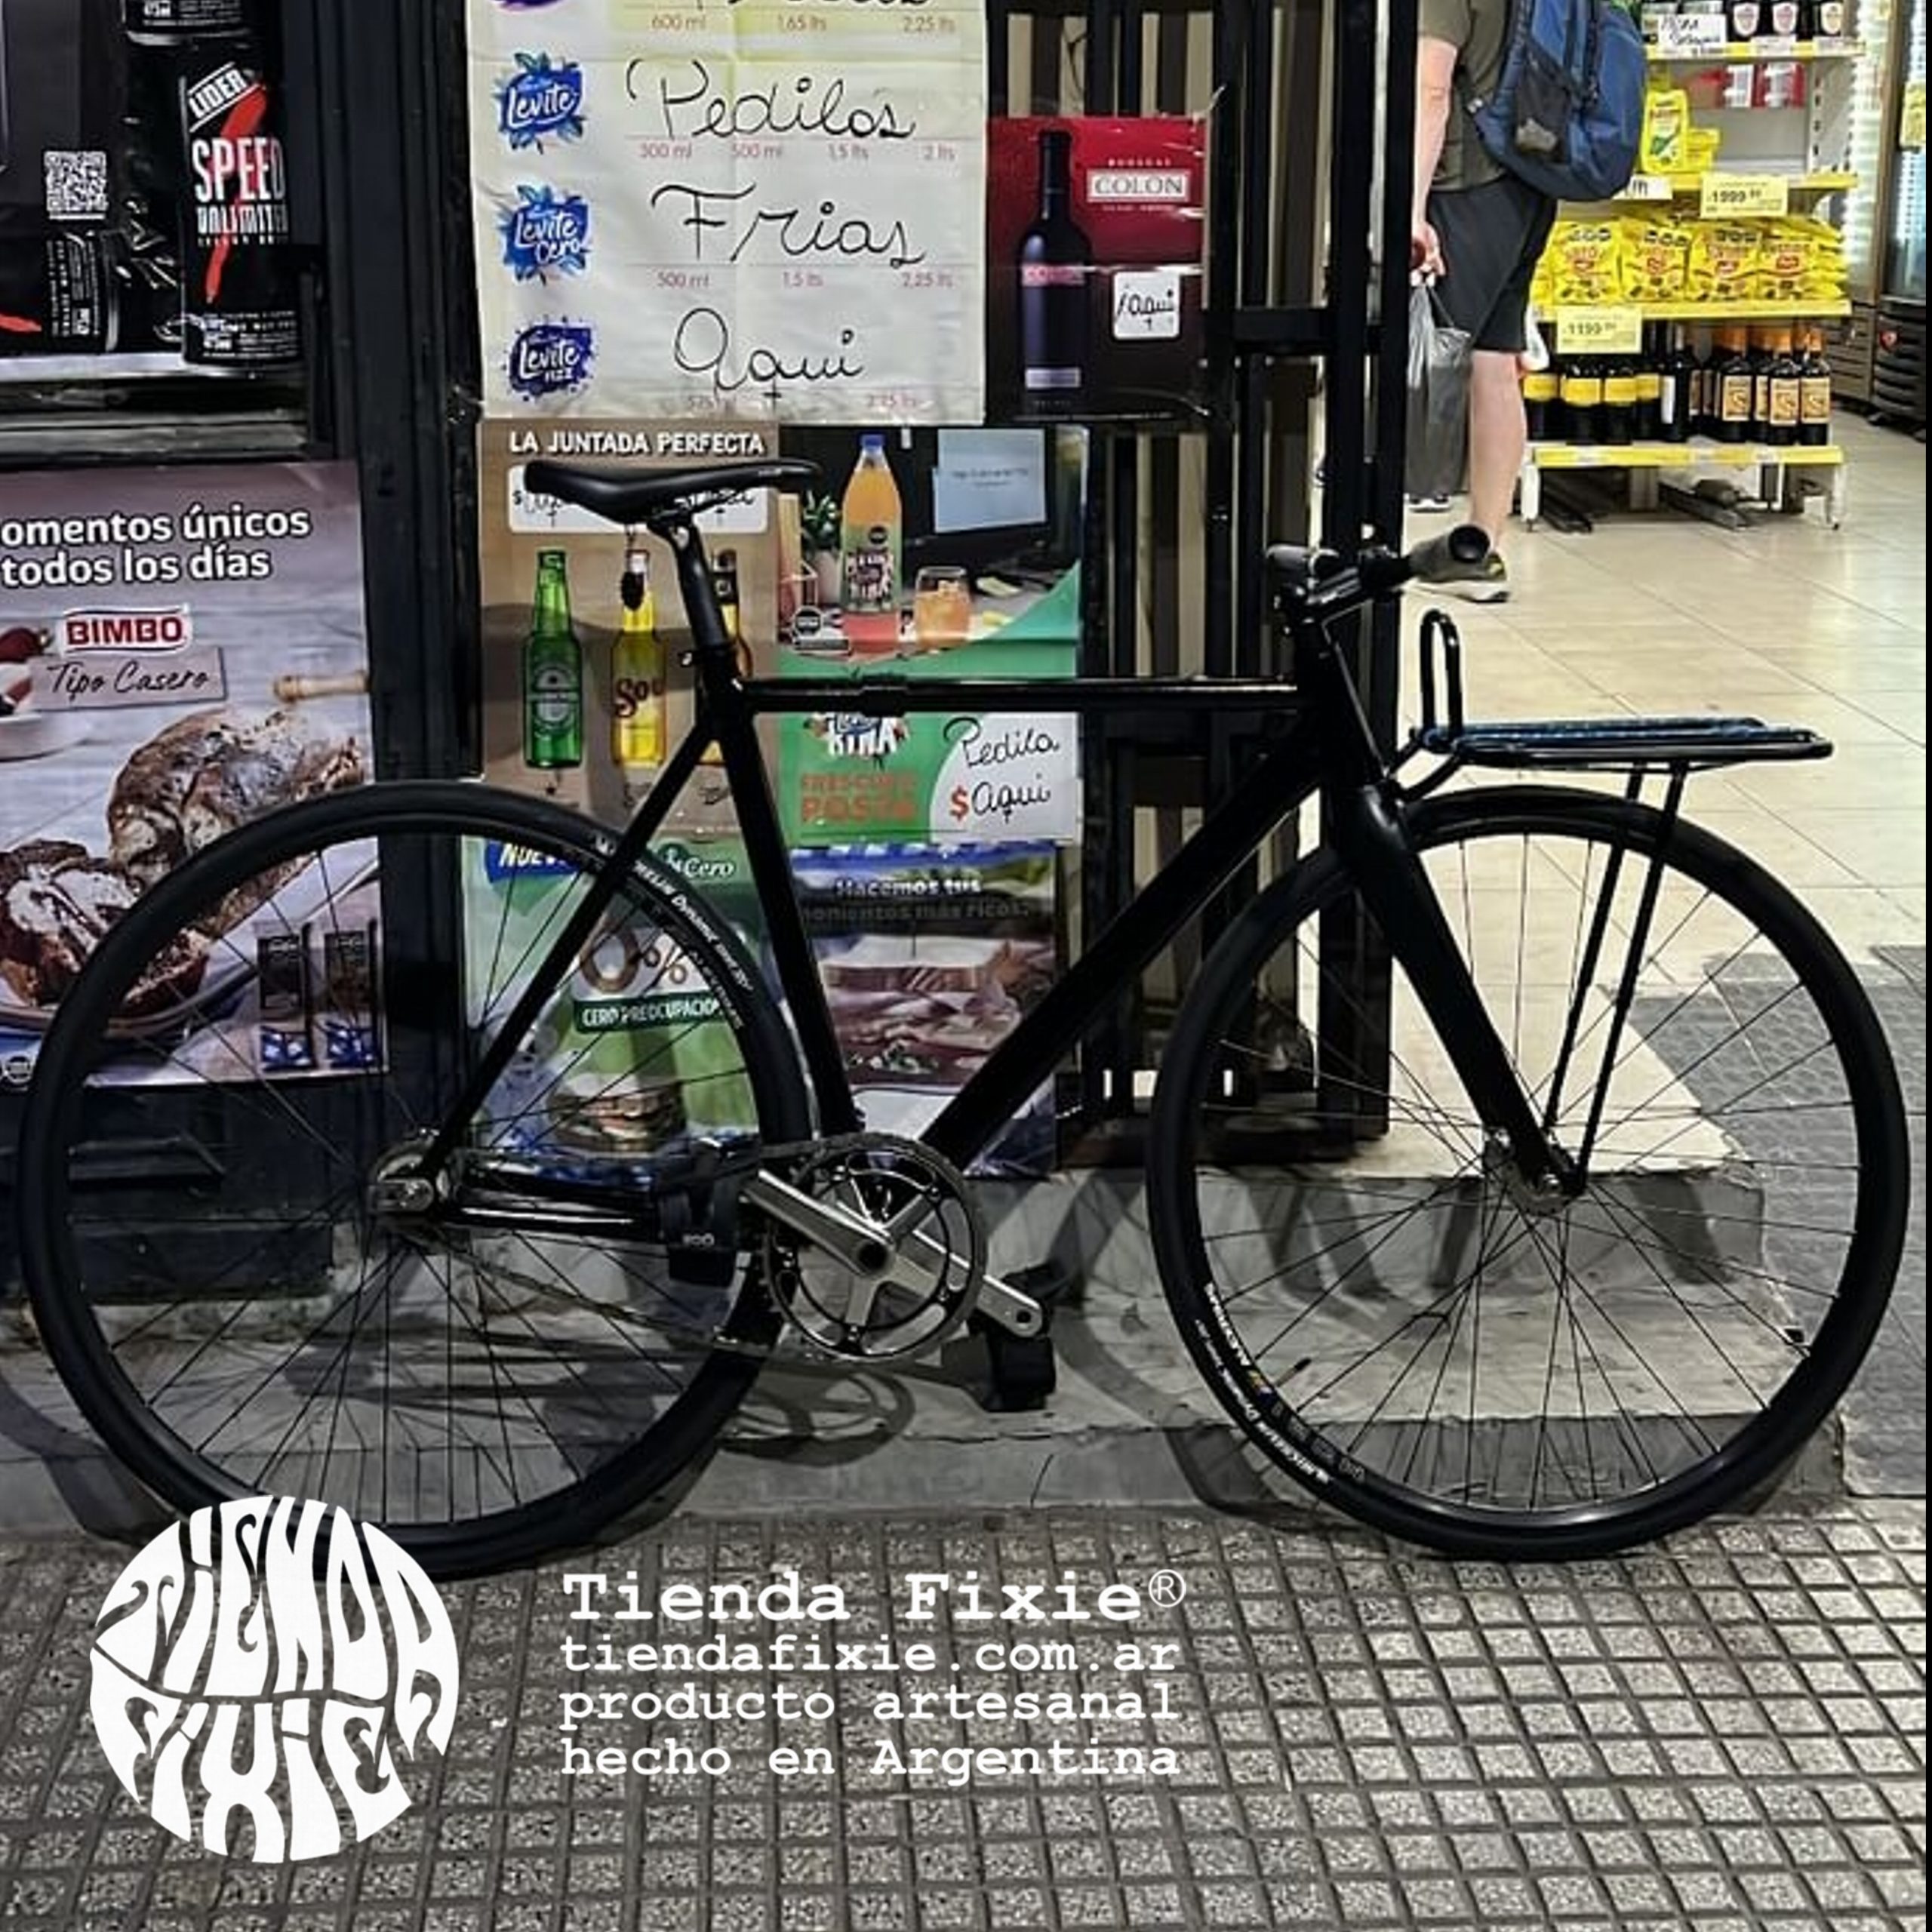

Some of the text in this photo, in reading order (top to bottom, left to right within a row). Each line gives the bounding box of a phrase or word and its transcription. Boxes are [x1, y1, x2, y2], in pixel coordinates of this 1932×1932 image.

[189, 69, 248, 118] LIDER
[626, 59, 916, 139] Pedilos
[192, 137, 287, 202] SPEED
[1094, 176, 1183, 194] COLON
[651, 184, 926, 269] Frias
[509, 431, 764, 453] LA JUNTADA PERFECTA
[183, 504, 311, 540] únicos
[2, 544, 271, 586] todos los días
[66, 617, 183, 645] BIMBO
[47, 659, 209, 702] Tipo Casero
[685, 857, 735, 878] Cero
[835, 878, 982, 897] Hacemos tus
[582, 1007, 619, 1027] CERO
